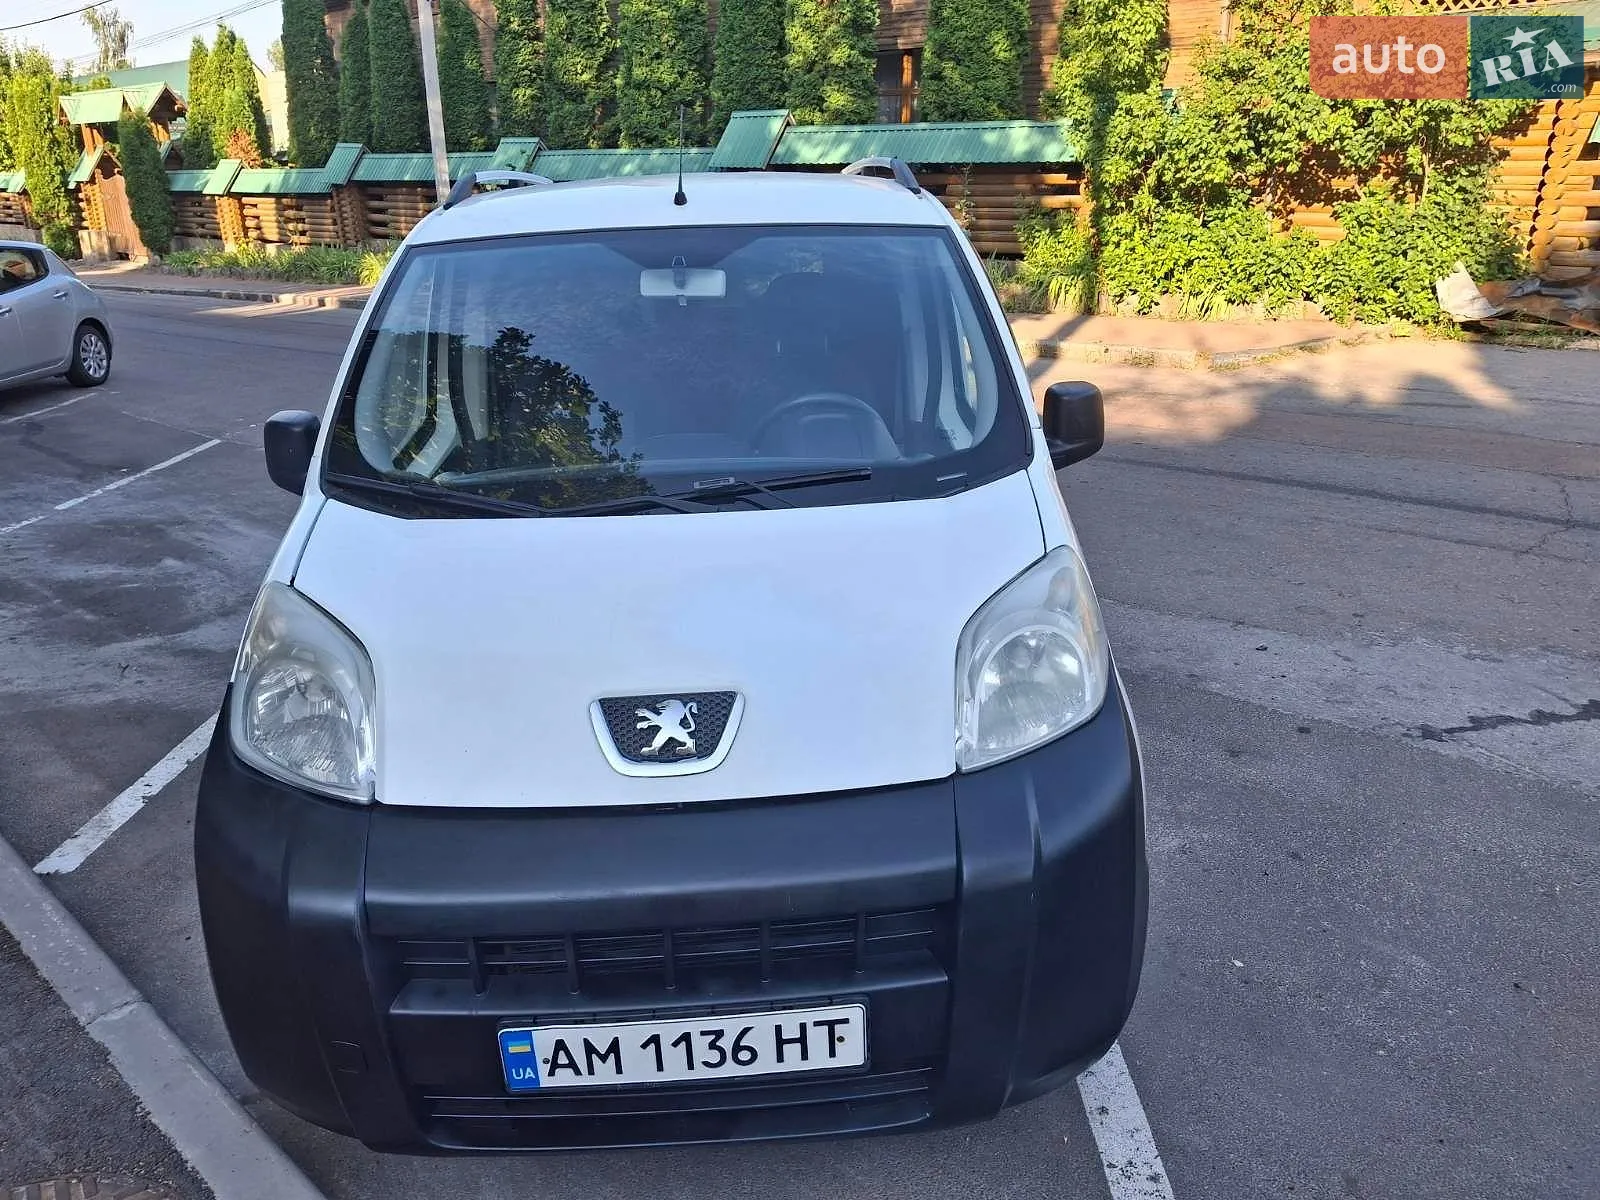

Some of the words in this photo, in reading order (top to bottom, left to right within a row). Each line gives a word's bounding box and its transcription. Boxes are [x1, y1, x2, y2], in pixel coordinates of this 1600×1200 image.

[547, 1036, 623, 1077] AM
[639, 1025, 759, 1072] 1136
[774, 1017, 850, 1063] HT
[511, 1066, 536, 1081] UA
